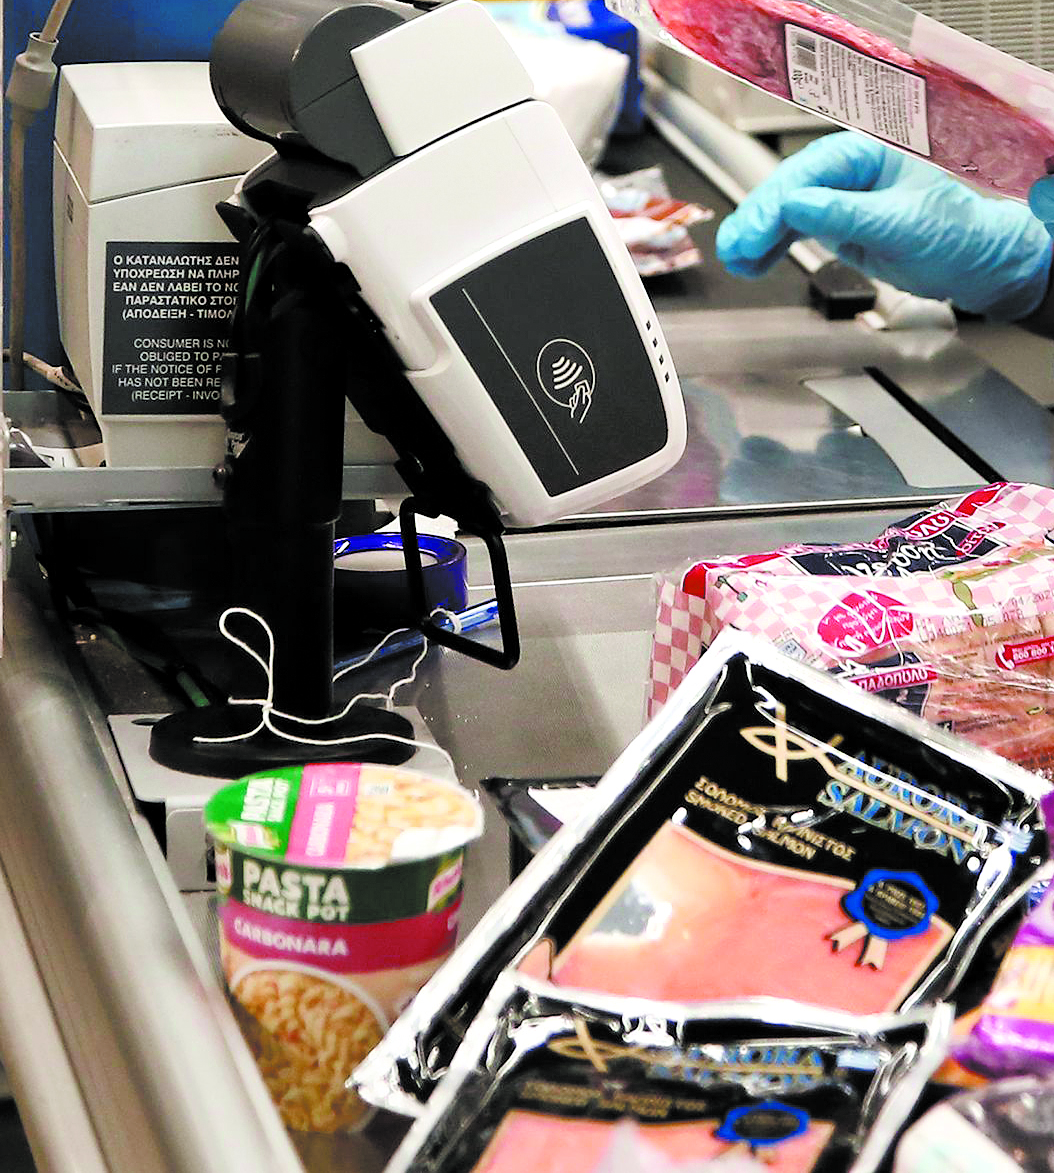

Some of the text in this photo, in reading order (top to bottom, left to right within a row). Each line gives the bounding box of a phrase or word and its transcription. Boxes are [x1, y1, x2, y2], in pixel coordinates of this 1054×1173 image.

[113, 255, 240, 266] Ο ΚΑΤΑΝΑΛΩΤΗΣ ΔΕΝ
[113, 269, 240, 279] ΥΠΟΧΡΕΩΣΗ ΝΑ ΠΛΗΡ
[113, 282, 137, 292] ΕΑΝ
[140, 282, 164, 292] ΔΕΝ
[167, 282, 202, 292] ΛΑΒΕΙ
[205, 283, 221, 292] ΤΟ
[125, 295, 207, 306] ΠΑΡΑΣΤΑΤΙΚΟ
[122, 309, 187, 320] (ΑΠΟΔΕΙΞΗ
[197, 309, 233, 319] ΤΙΜΟΛ
[134, 338, 200, 348] CONSUMER
[203, 338, 214, 348] IS
[140, 352, 191, 362] OBLIGED
[194, 352, 209, 361] TO
[112, 364, 122, 374] IF
[125, 364, 148, 374] THE
[151, 364, 193, 374] NOTICE
[197, 364, 212, 374] OF
[118, 378, 221, 387] HAS NOT BEEN RE
[132, 390, 183, 402] (RECEIPT
[193, 391, 220, 400] INVO
[838, 751, 987, 842] AURORA
[684, 790, 818, 861] SMOKED ALMON
[817, 779, 972, 865] SALMON
[243, 858, 350, 907] PASTA
[242, 890, 350, 922] SNACK POT
[234, 916, 349, 956] CARBONARA
